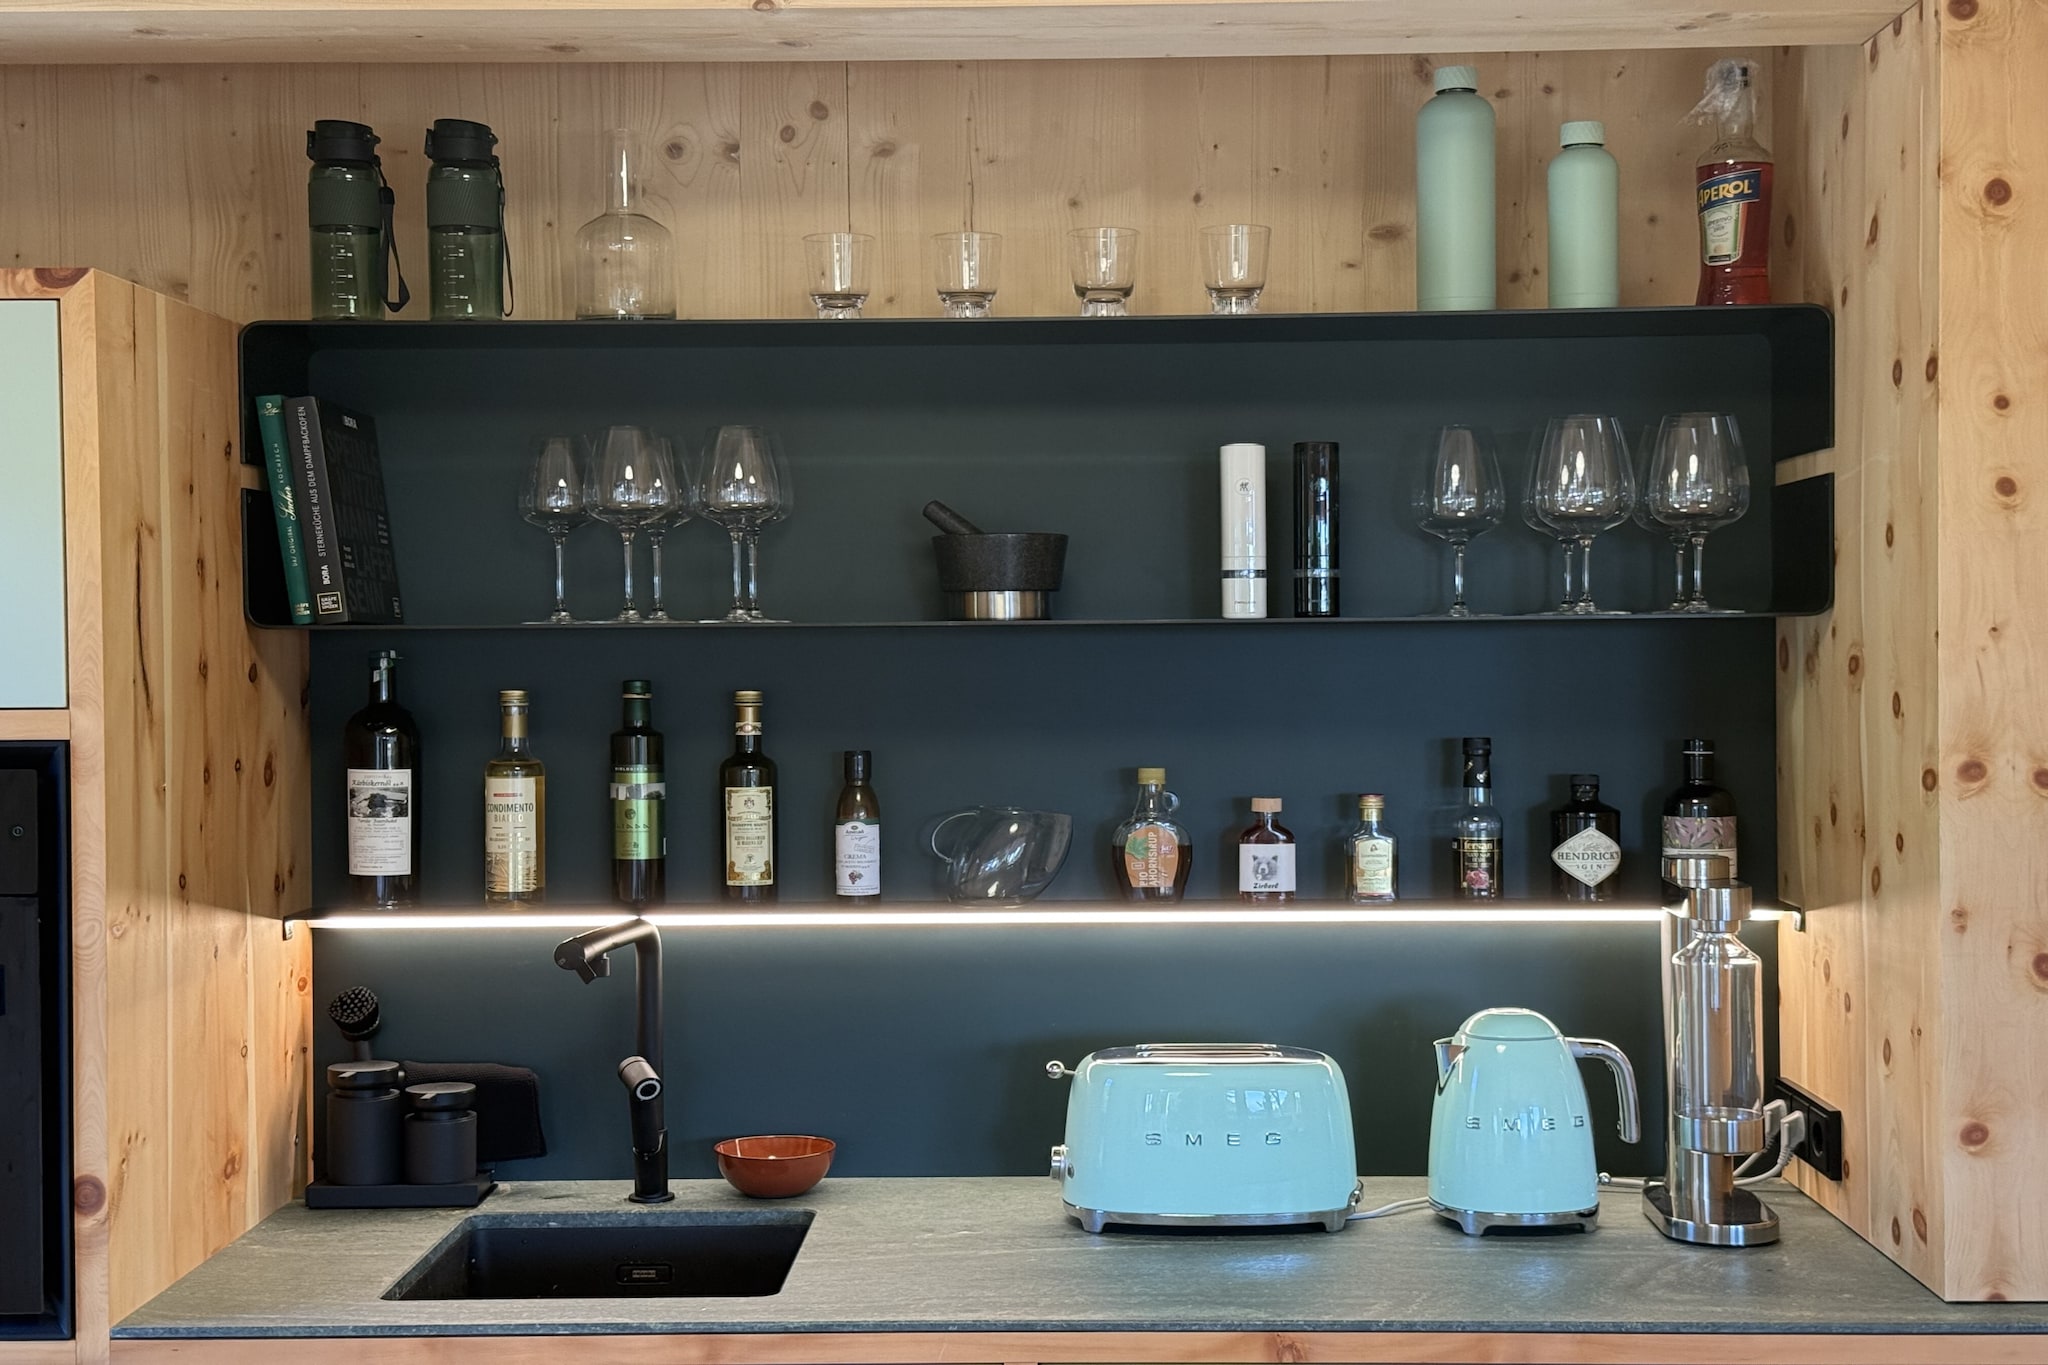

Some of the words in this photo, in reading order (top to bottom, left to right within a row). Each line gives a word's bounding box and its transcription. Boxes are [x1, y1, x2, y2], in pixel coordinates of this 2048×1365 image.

[1697, 180, 1752, 207] APEROL
[298, 406, 314, 469] DAMPFBACKOFEN
[306, 472, 316, 487] DEM
[310, 488, 319, 504] AUS
[285, 526, 297, 554] ORIGINAL
[312, 504, 326, 557] STERNEKÜCHE
[320, 564, 330, 585] BORA
[487, 802, 534, 813] CONDIMENTO
[1148, 832, 1158, 887] AHORNSIRUP
[1466, 1115, 1584, 1132] SMEG
[1145, 1132, 1282, 1146] SMEG
